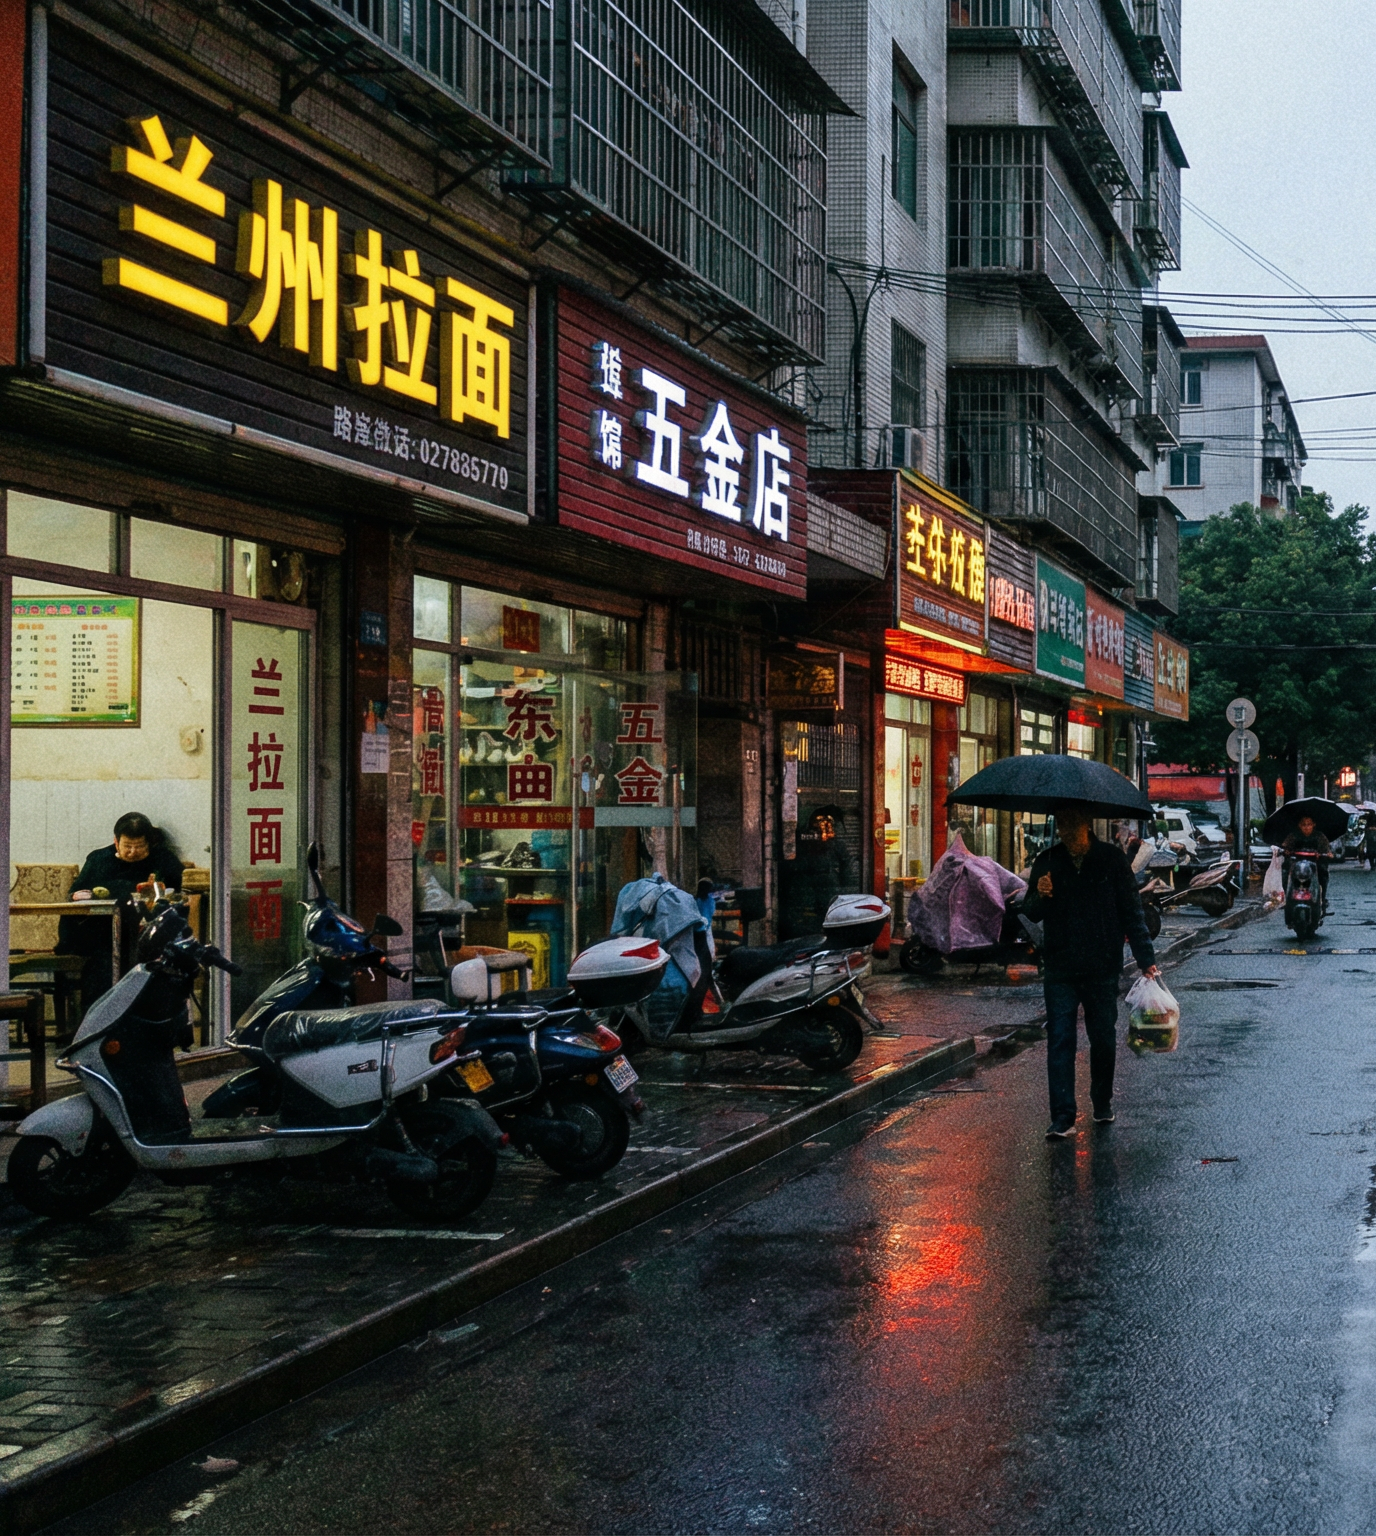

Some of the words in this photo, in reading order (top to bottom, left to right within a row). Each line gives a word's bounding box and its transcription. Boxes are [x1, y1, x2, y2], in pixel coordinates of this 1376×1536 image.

[103, 115, 515, 439] 兰州拉面
[634, 367, 791, 543] 五金店
[616, 702, 663, 804] 五金
